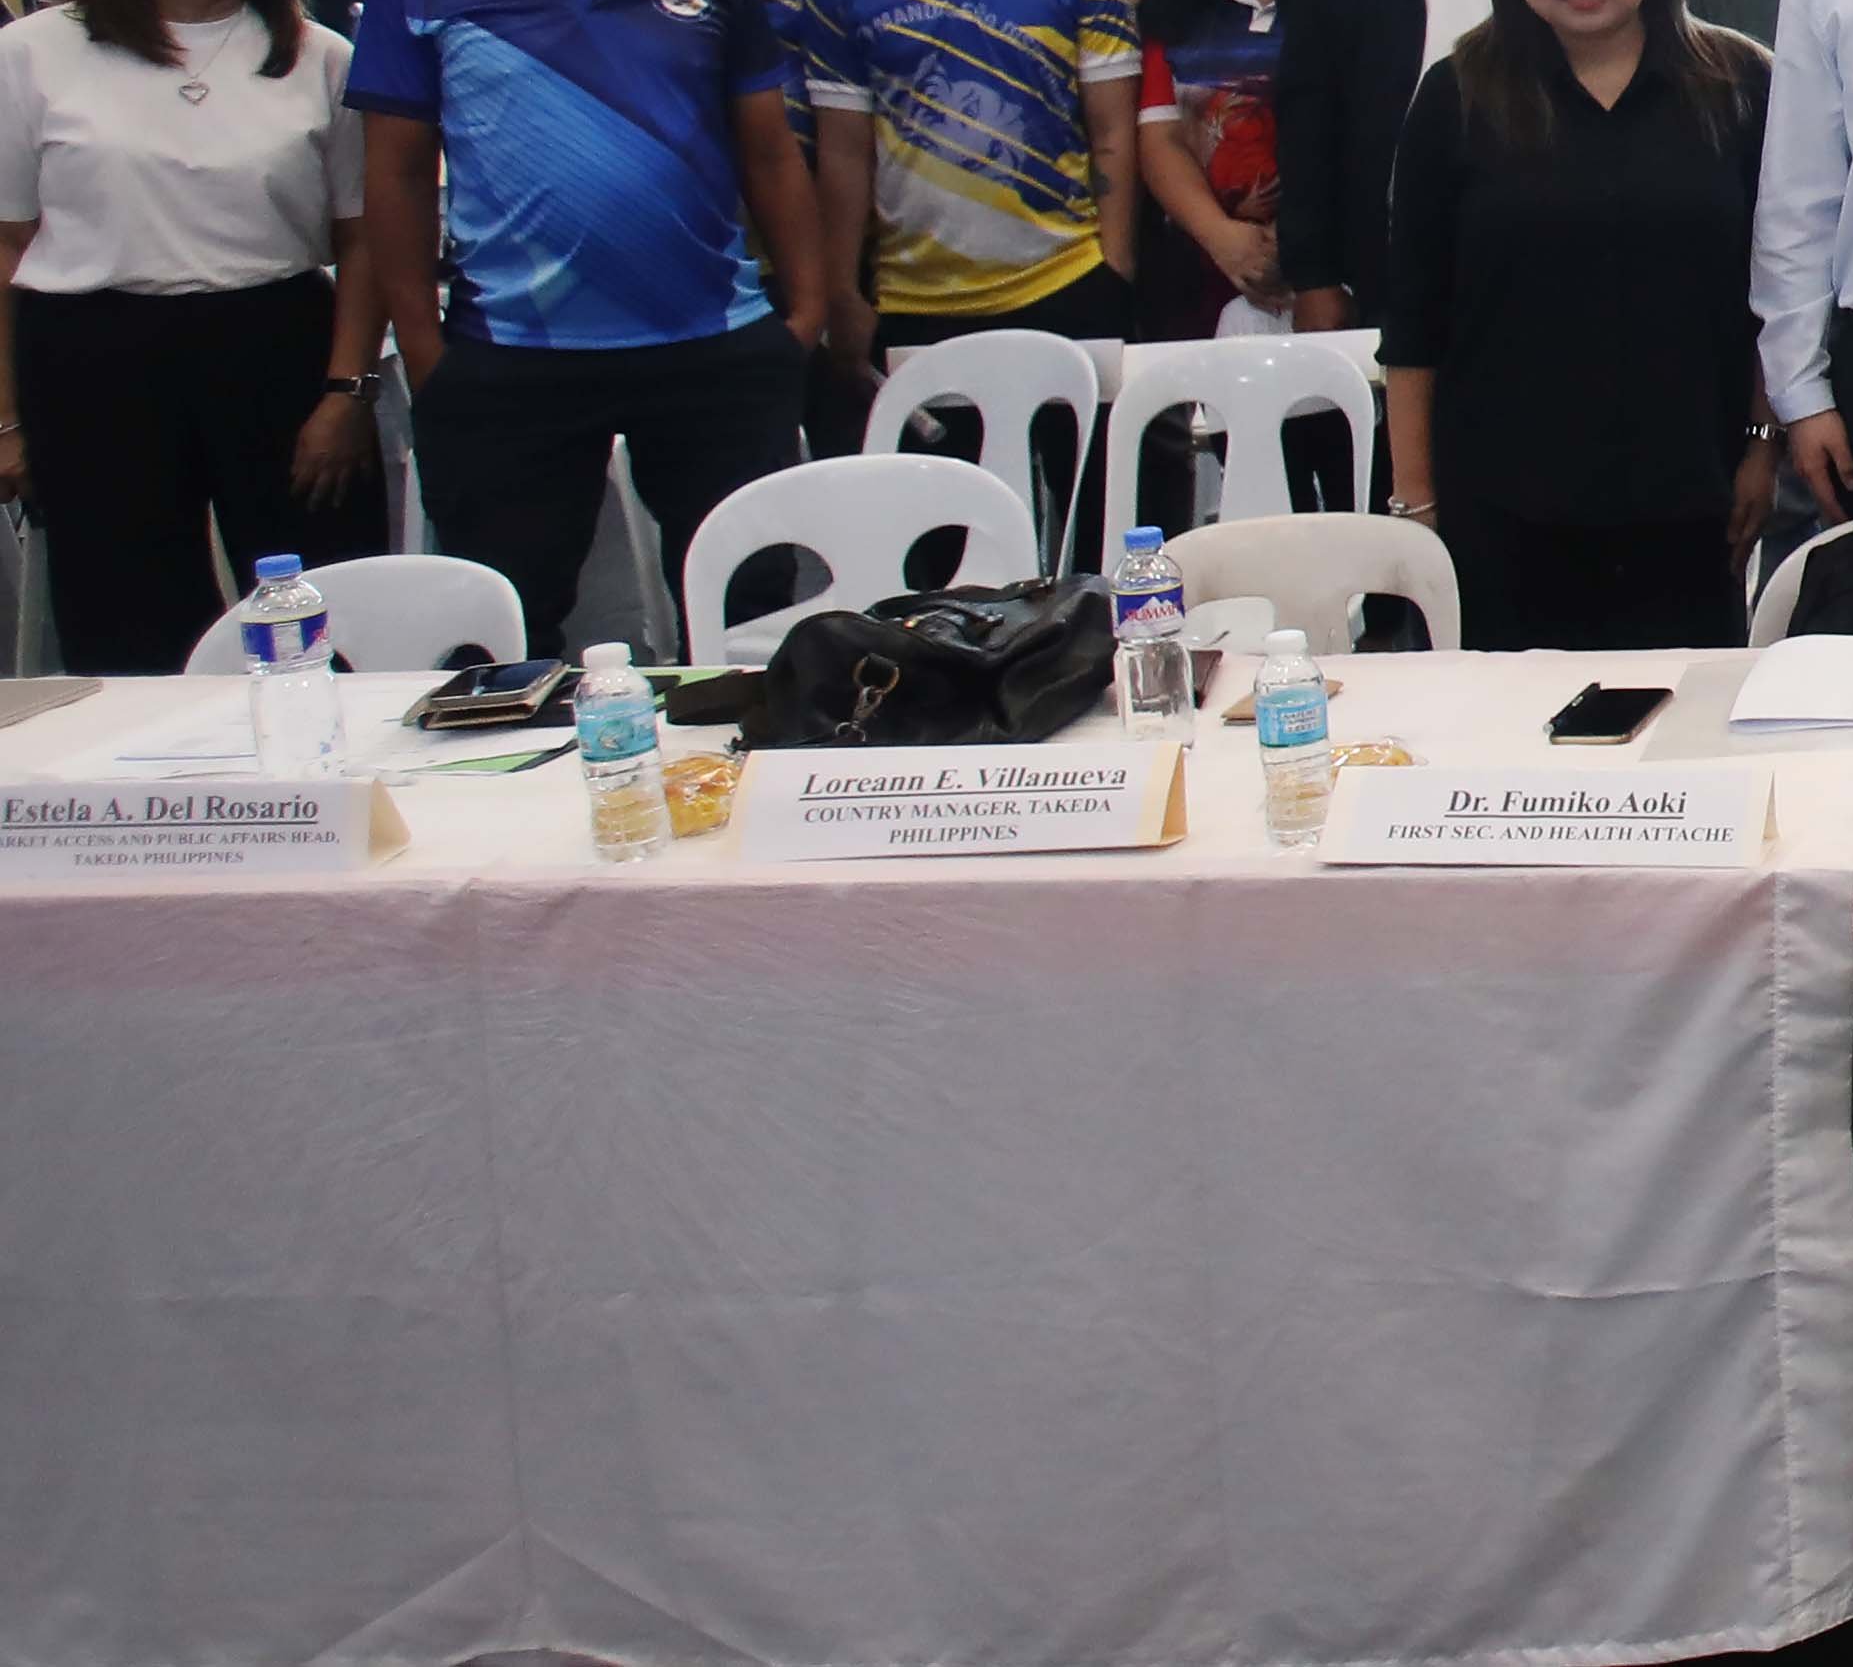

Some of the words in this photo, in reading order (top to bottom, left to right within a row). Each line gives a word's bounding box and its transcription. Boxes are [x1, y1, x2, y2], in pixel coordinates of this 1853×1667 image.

[803, 768, 926, 795] Loreann
[932, 768, 963, 791] E.
[978, 764, 1127, 789] Villanueva
[2, 797, 92, 823] Estela
[101, 797, 134, 822] A.
[145, 795, 194, 821] Del
[205, 794, 319, 820] Rosario
[804, 801, 906, 824] COUNTRY
[1027, 796, 1112, 816] TAKEDA
[1448, 790, 1490, 813] Dr.
[1501, 790, 1610, 814] Fumiko
[1617, 791, 1687, 814] Aoki
[118, 833, 153, 845] AND
[888, 824, 1018, 845] PHILIPPINES
[1387, 824, 1447, 839] FIRST
[1450, 824, 1495, 840] SEC.
[1501, 825, 1544, 840] AND
[1549, 825, 1633, 841] HEALTH
[1636, 826, 1735, 843] ATTACHE
[144, 851, 245, 865] PHILIPPINES
